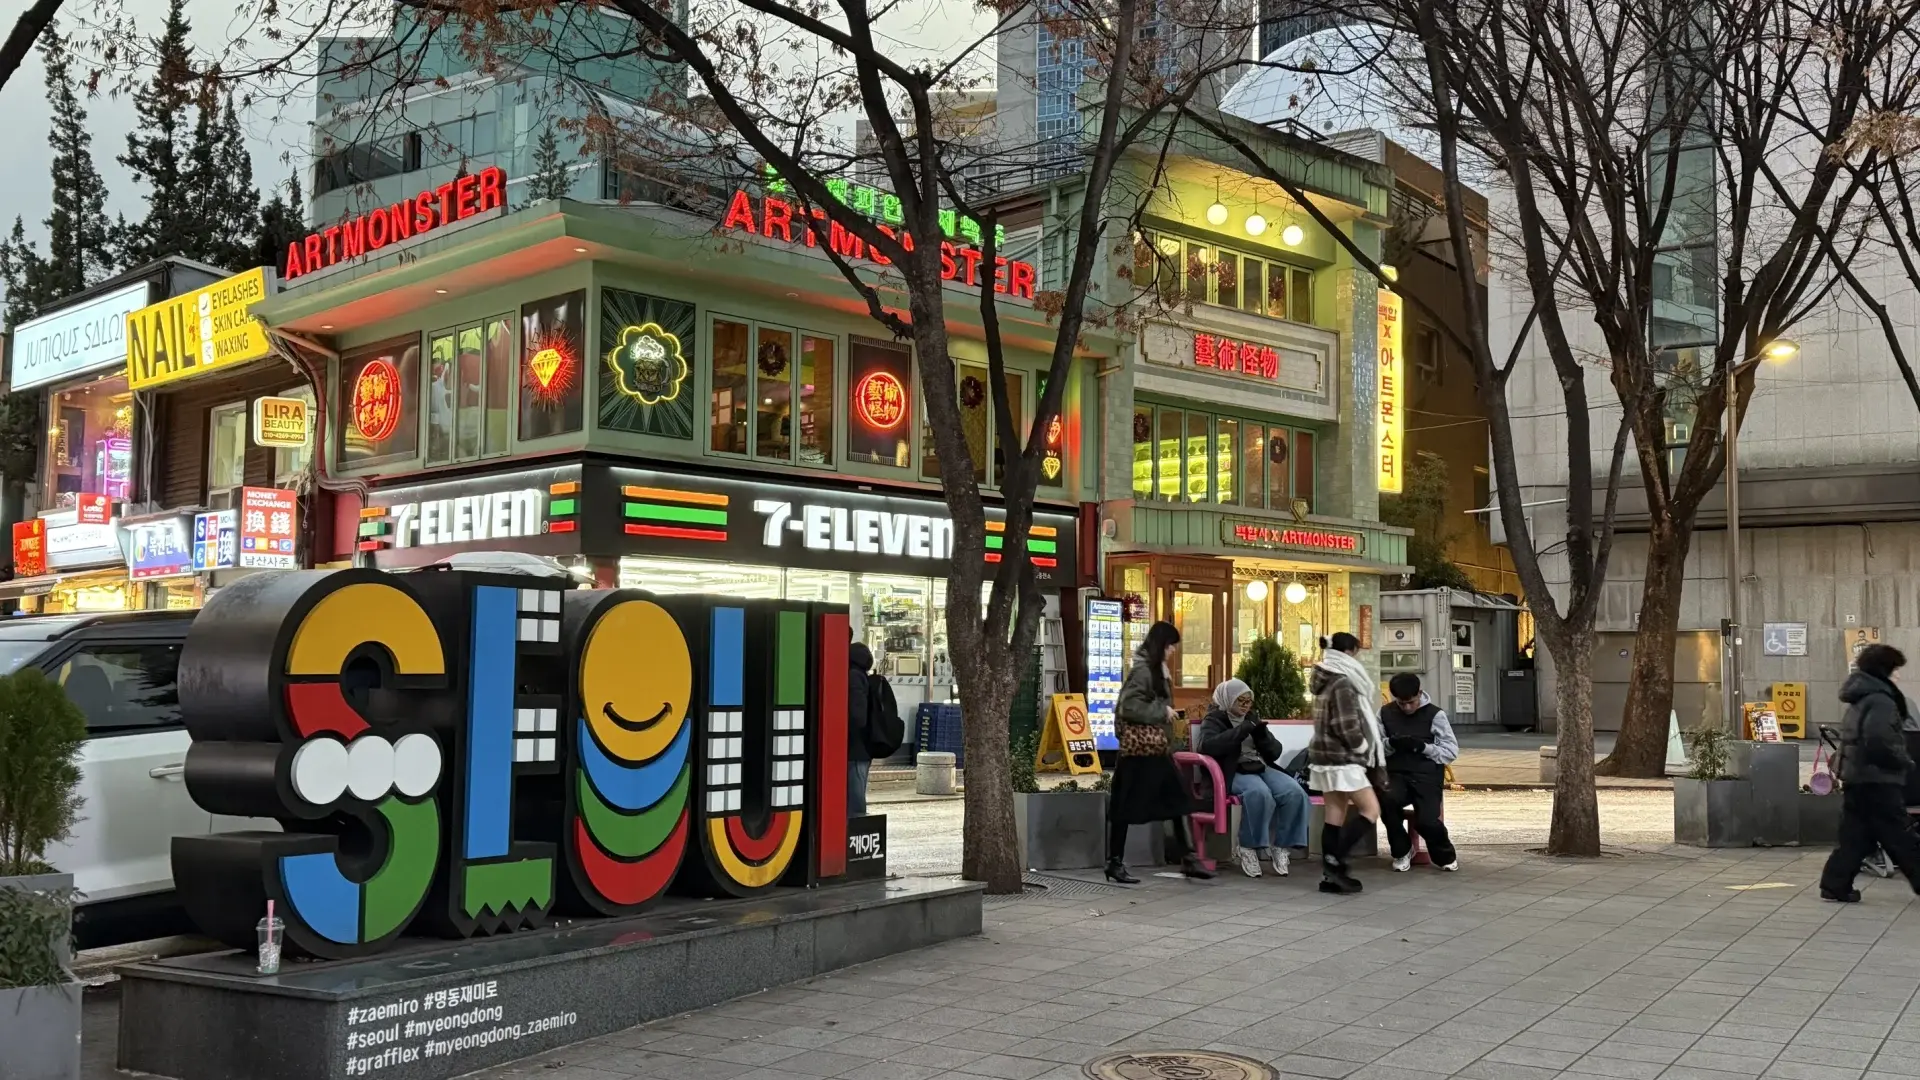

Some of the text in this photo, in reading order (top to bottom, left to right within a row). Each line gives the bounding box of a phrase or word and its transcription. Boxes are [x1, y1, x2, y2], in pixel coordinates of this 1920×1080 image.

[285, 166, 506, 281] ARTMONSTER
[212, 278, 259, 309] EYELASHES
[213, 311, 233, 334] SKIN
[130, 302, 196, 382] NAIL
[215, 332, 249, 357] WAXING
[1194, 333, 1280, 379] 藝術怪物
[264, 403, 304, 420] LIRA
[1381, 347, 1394, 478] 아트몬스터
[264, 419, 304, 430] BEAUTY
[246, 491, 277, 500] MONEY
[246, 499, 292, 509] EXCHANGE
[245, 510, 291, 535] 換錢
[1281, 530, 1355, 550] ARTMONSTER
[244, 556, 289, 568] 남산사주
[1068, 741, 1094, 751] 금연구역
[172, 568, 850, 958] SEOUL
[348, 980, 498, 1025] #zaemiro #명동재미로
[347, 1005, 503, 1050] #seoul #myeongdong
[346, 1010, 577, 1076] #grafflex #myeongdong_zaemiro
